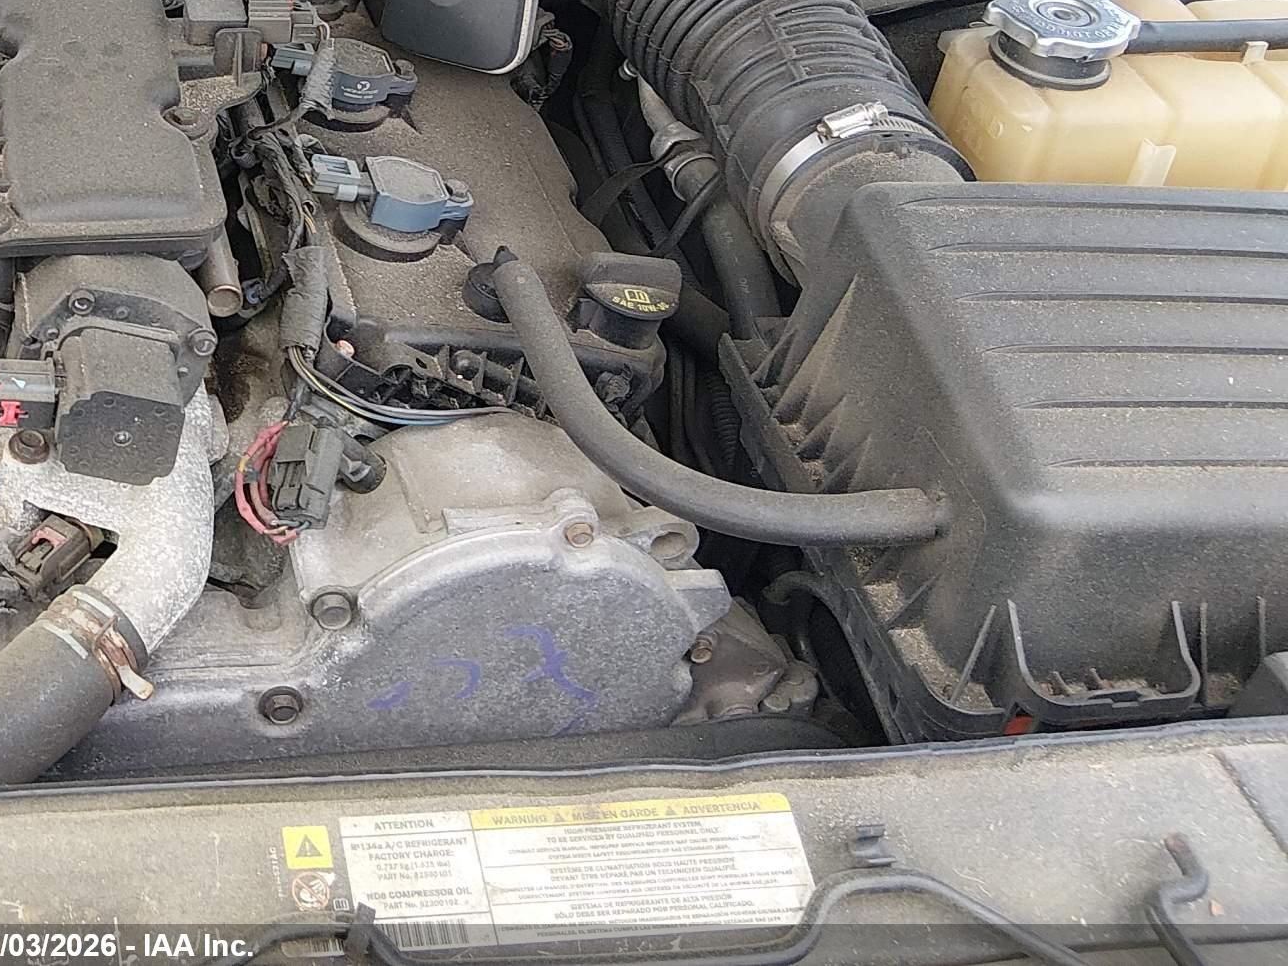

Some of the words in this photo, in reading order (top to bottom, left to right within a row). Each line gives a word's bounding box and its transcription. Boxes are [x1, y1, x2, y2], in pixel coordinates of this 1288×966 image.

[612, 296, 635, 309] SAE
[492, 814, 548, 826] WARNING
[603, 809, 618, 819] EN
[621, 807, 659, 818] GARDE
[682, 801, 760, 815] ADVERTENCIA
[374, 818, 435, 831] ATTENTION
[404, 837, 468, 849] REFRIGERANT
[368, 851, 411, 861] FACTORY
[388, 887, 453, 899] COMPRESSOR
[456, 886, 472, 896] OIL
